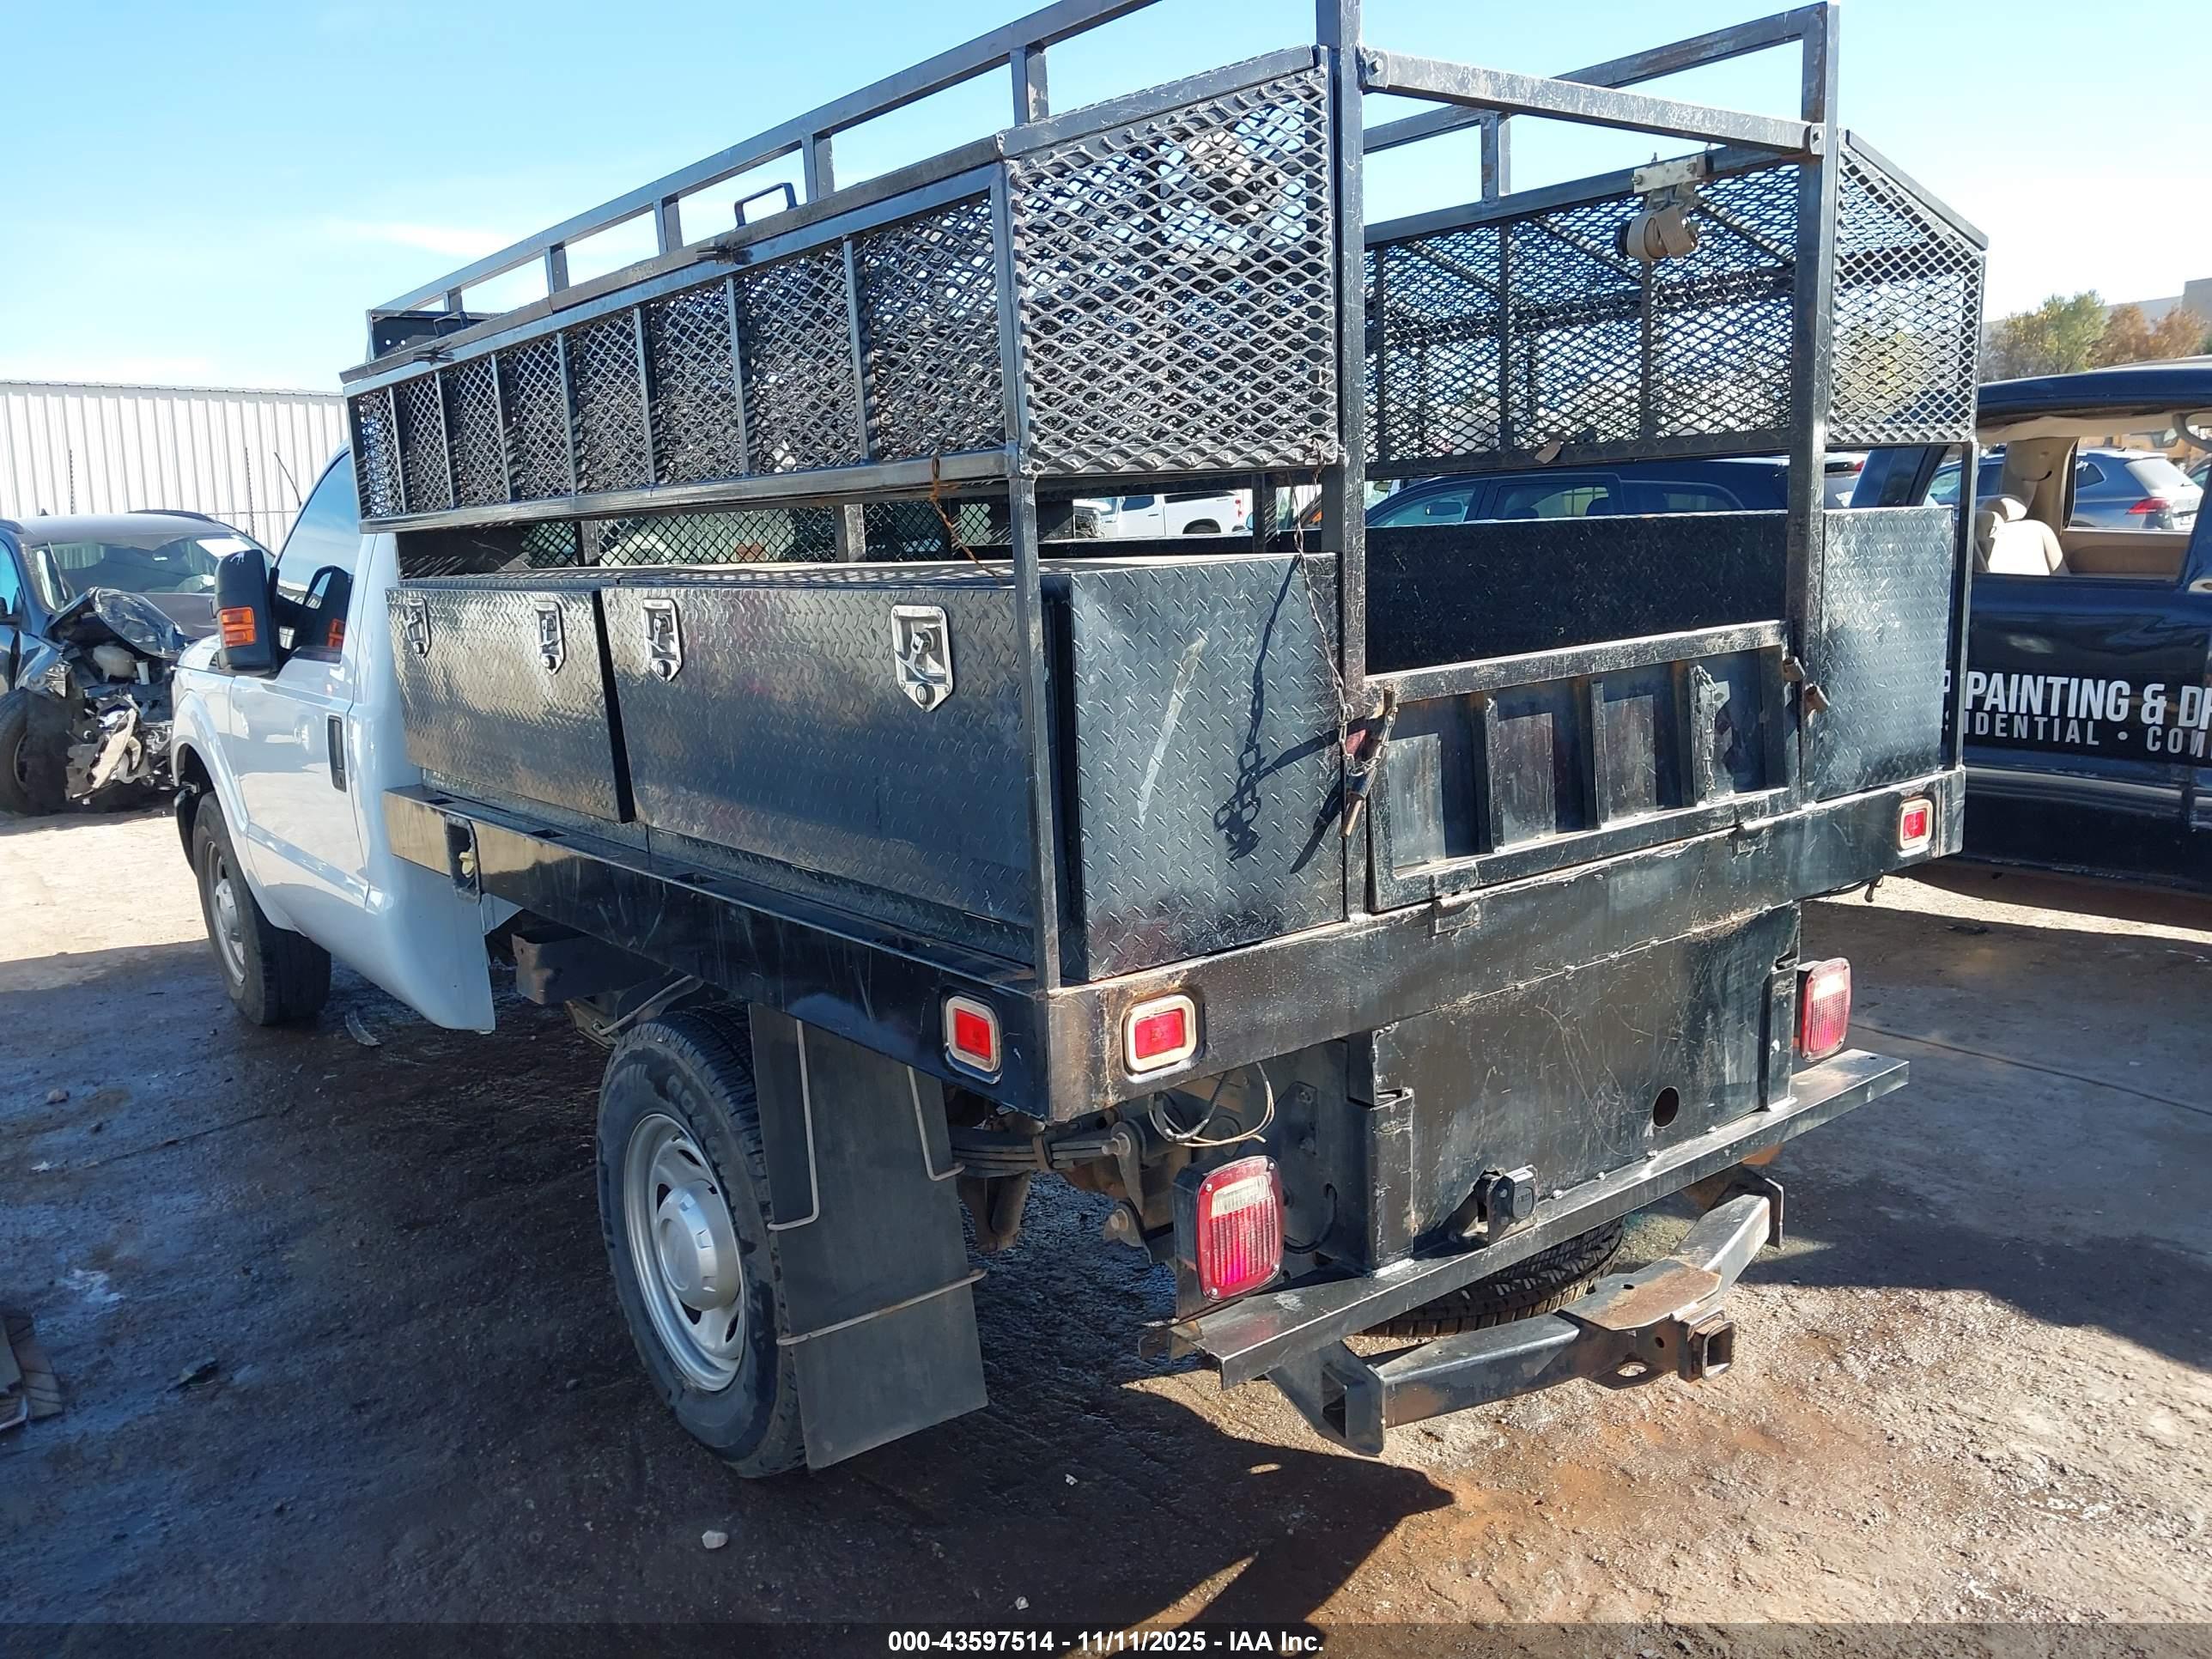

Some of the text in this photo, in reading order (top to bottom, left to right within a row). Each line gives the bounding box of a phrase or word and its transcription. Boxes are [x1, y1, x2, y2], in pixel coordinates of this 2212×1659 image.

[1965, 671, 2131, 722] PAINTING
[2140, 683, 2167, 726] &
[1945, 710, 2100, 746] IDENTIAL
[2146, 726, 2212, 760] COM
